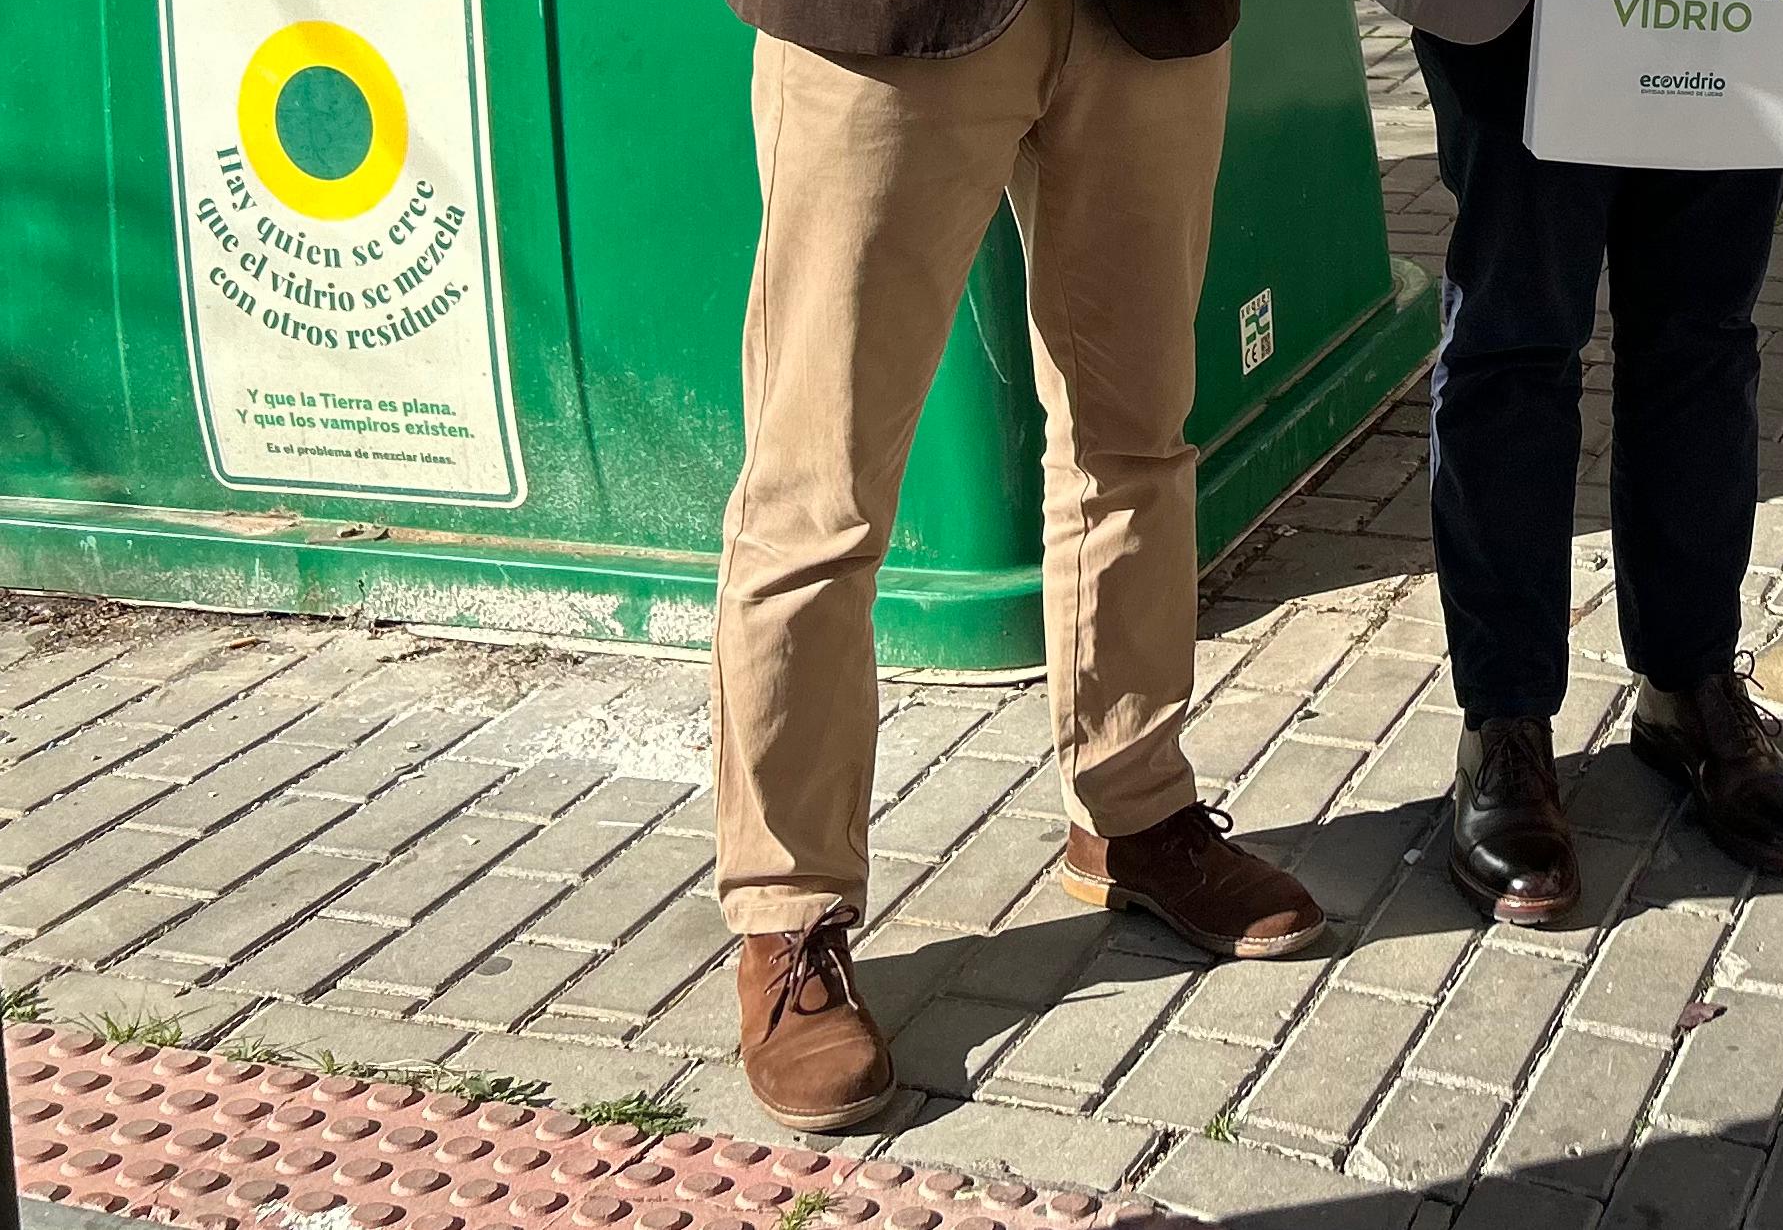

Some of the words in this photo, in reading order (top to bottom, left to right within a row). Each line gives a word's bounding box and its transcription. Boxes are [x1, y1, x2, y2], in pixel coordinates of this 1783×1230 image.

[1639, 71, 1726, 91] ecovidrio
[216, 145, 257, 212] Hay
[257, 216, 342, 268] quien
[352, 239, 384, 267] se
[388, 179, 434, 245] cree
[196, 197, 240, 253] que
[240, 254, 268, 281] el
[271, 270, 355, 312] vidrio
[362, 282, 392, 309] se
[394, 204, 466, 296] mezcla
[209, 266, 257, 317] con
[262, 308, 339, 349] otros
[346, 284, 469, 350] residuos.
[247, 389, 258, 403] Y
[264, 391, 296, 409] que
[301, 392, 317, 407] la
[319, 393, 373, 410] Tierra
[378, 399, 398, 412] es
[402, 399, 457, 417] plana.
[236, 409, 248, 424] Y
[254, 412, 285, 429] que
[290, 412, 316, 428] los
[319, 415, 401, 434] vampiros
[405, 421, 475, 438] existen.
[266, 442, 281, 454] Es
[283, 445, 294, 454] el
[297, 445, 352, 458] problema
[354, 448, 369, 459] de
[372, 451, 418, 462] mezclar
[421, 452, 457, 465] ideas.
